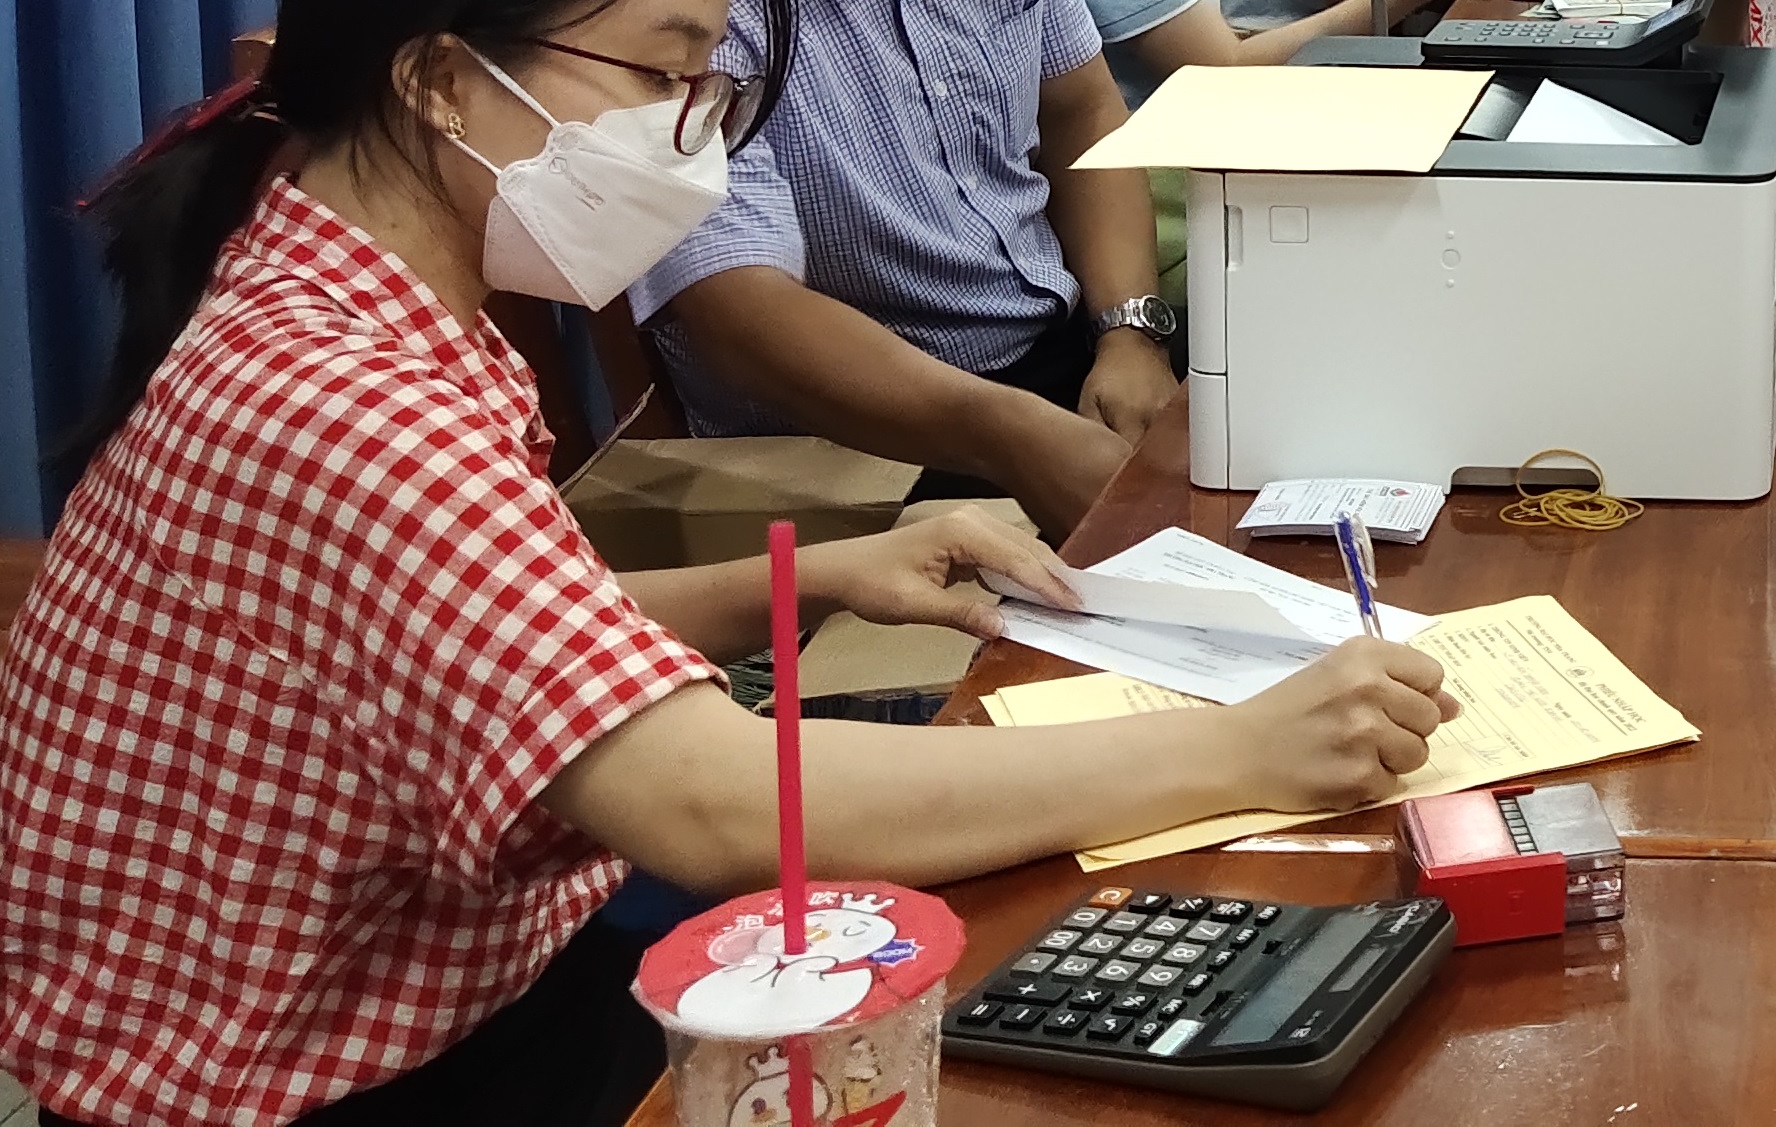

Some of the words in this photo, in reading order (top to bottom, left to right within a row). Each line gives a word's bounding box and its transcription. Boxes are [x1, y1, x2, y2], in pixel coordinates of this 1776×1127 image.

[1099, 890, 1121, 901] C
[1073, 912, 1096, 921] 0
[1154, 920, 1176, 932] 4
[1199, 926, 1222, 937] 7
[1044, 931, 1074, 946] 00
[1087, 938, 1113, 949] 2
[1130, 942, 1155, 954] 5
[1172, 947, 1197, 958] 8
[1063, 960, 1088, 972] 3
[1106, 965, 1129, 976] 6
[1150, 971, 1173, 982] 9
